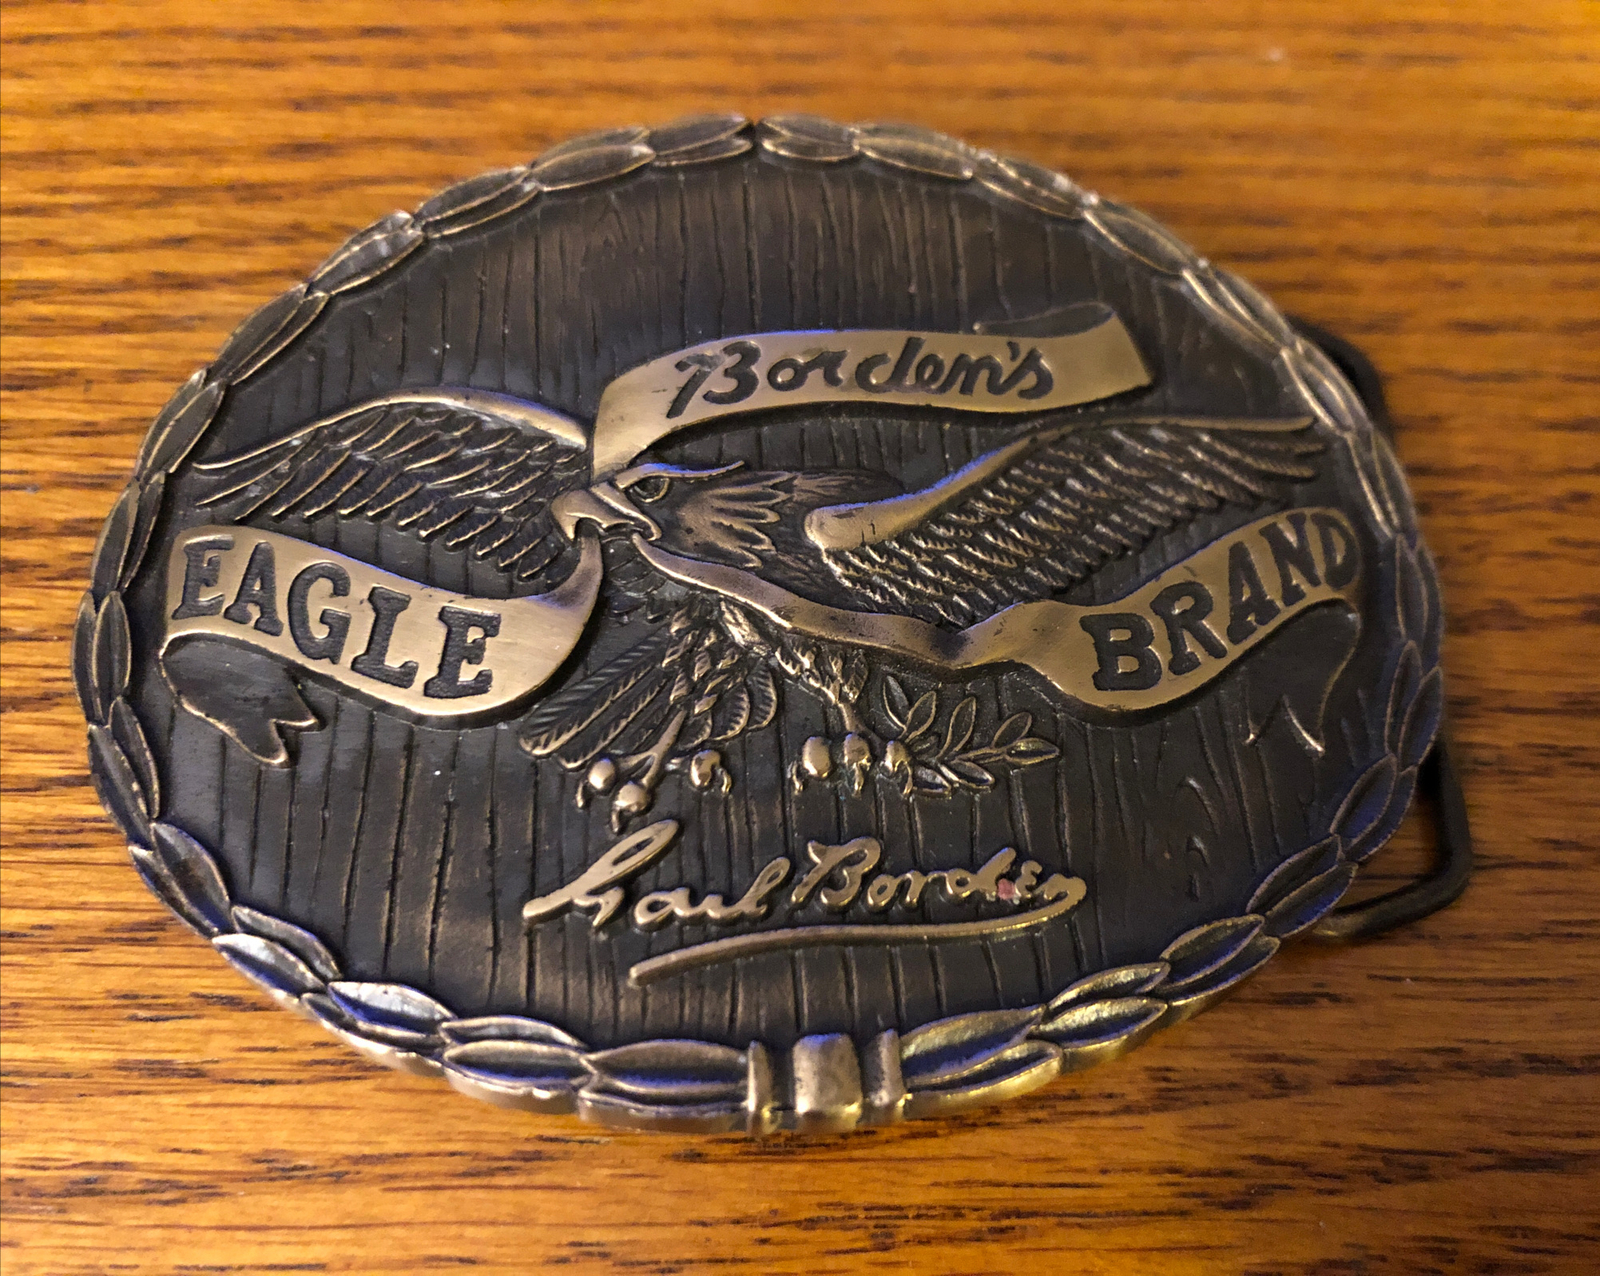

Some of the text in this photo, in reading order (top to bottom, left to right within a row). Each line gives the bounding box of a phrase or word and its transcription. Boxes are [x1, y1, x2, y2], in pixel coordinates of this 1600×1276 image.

[667, 337, 1054, 419] Borden's
[172, 511, 1359, 699] EAGLE BRAND
